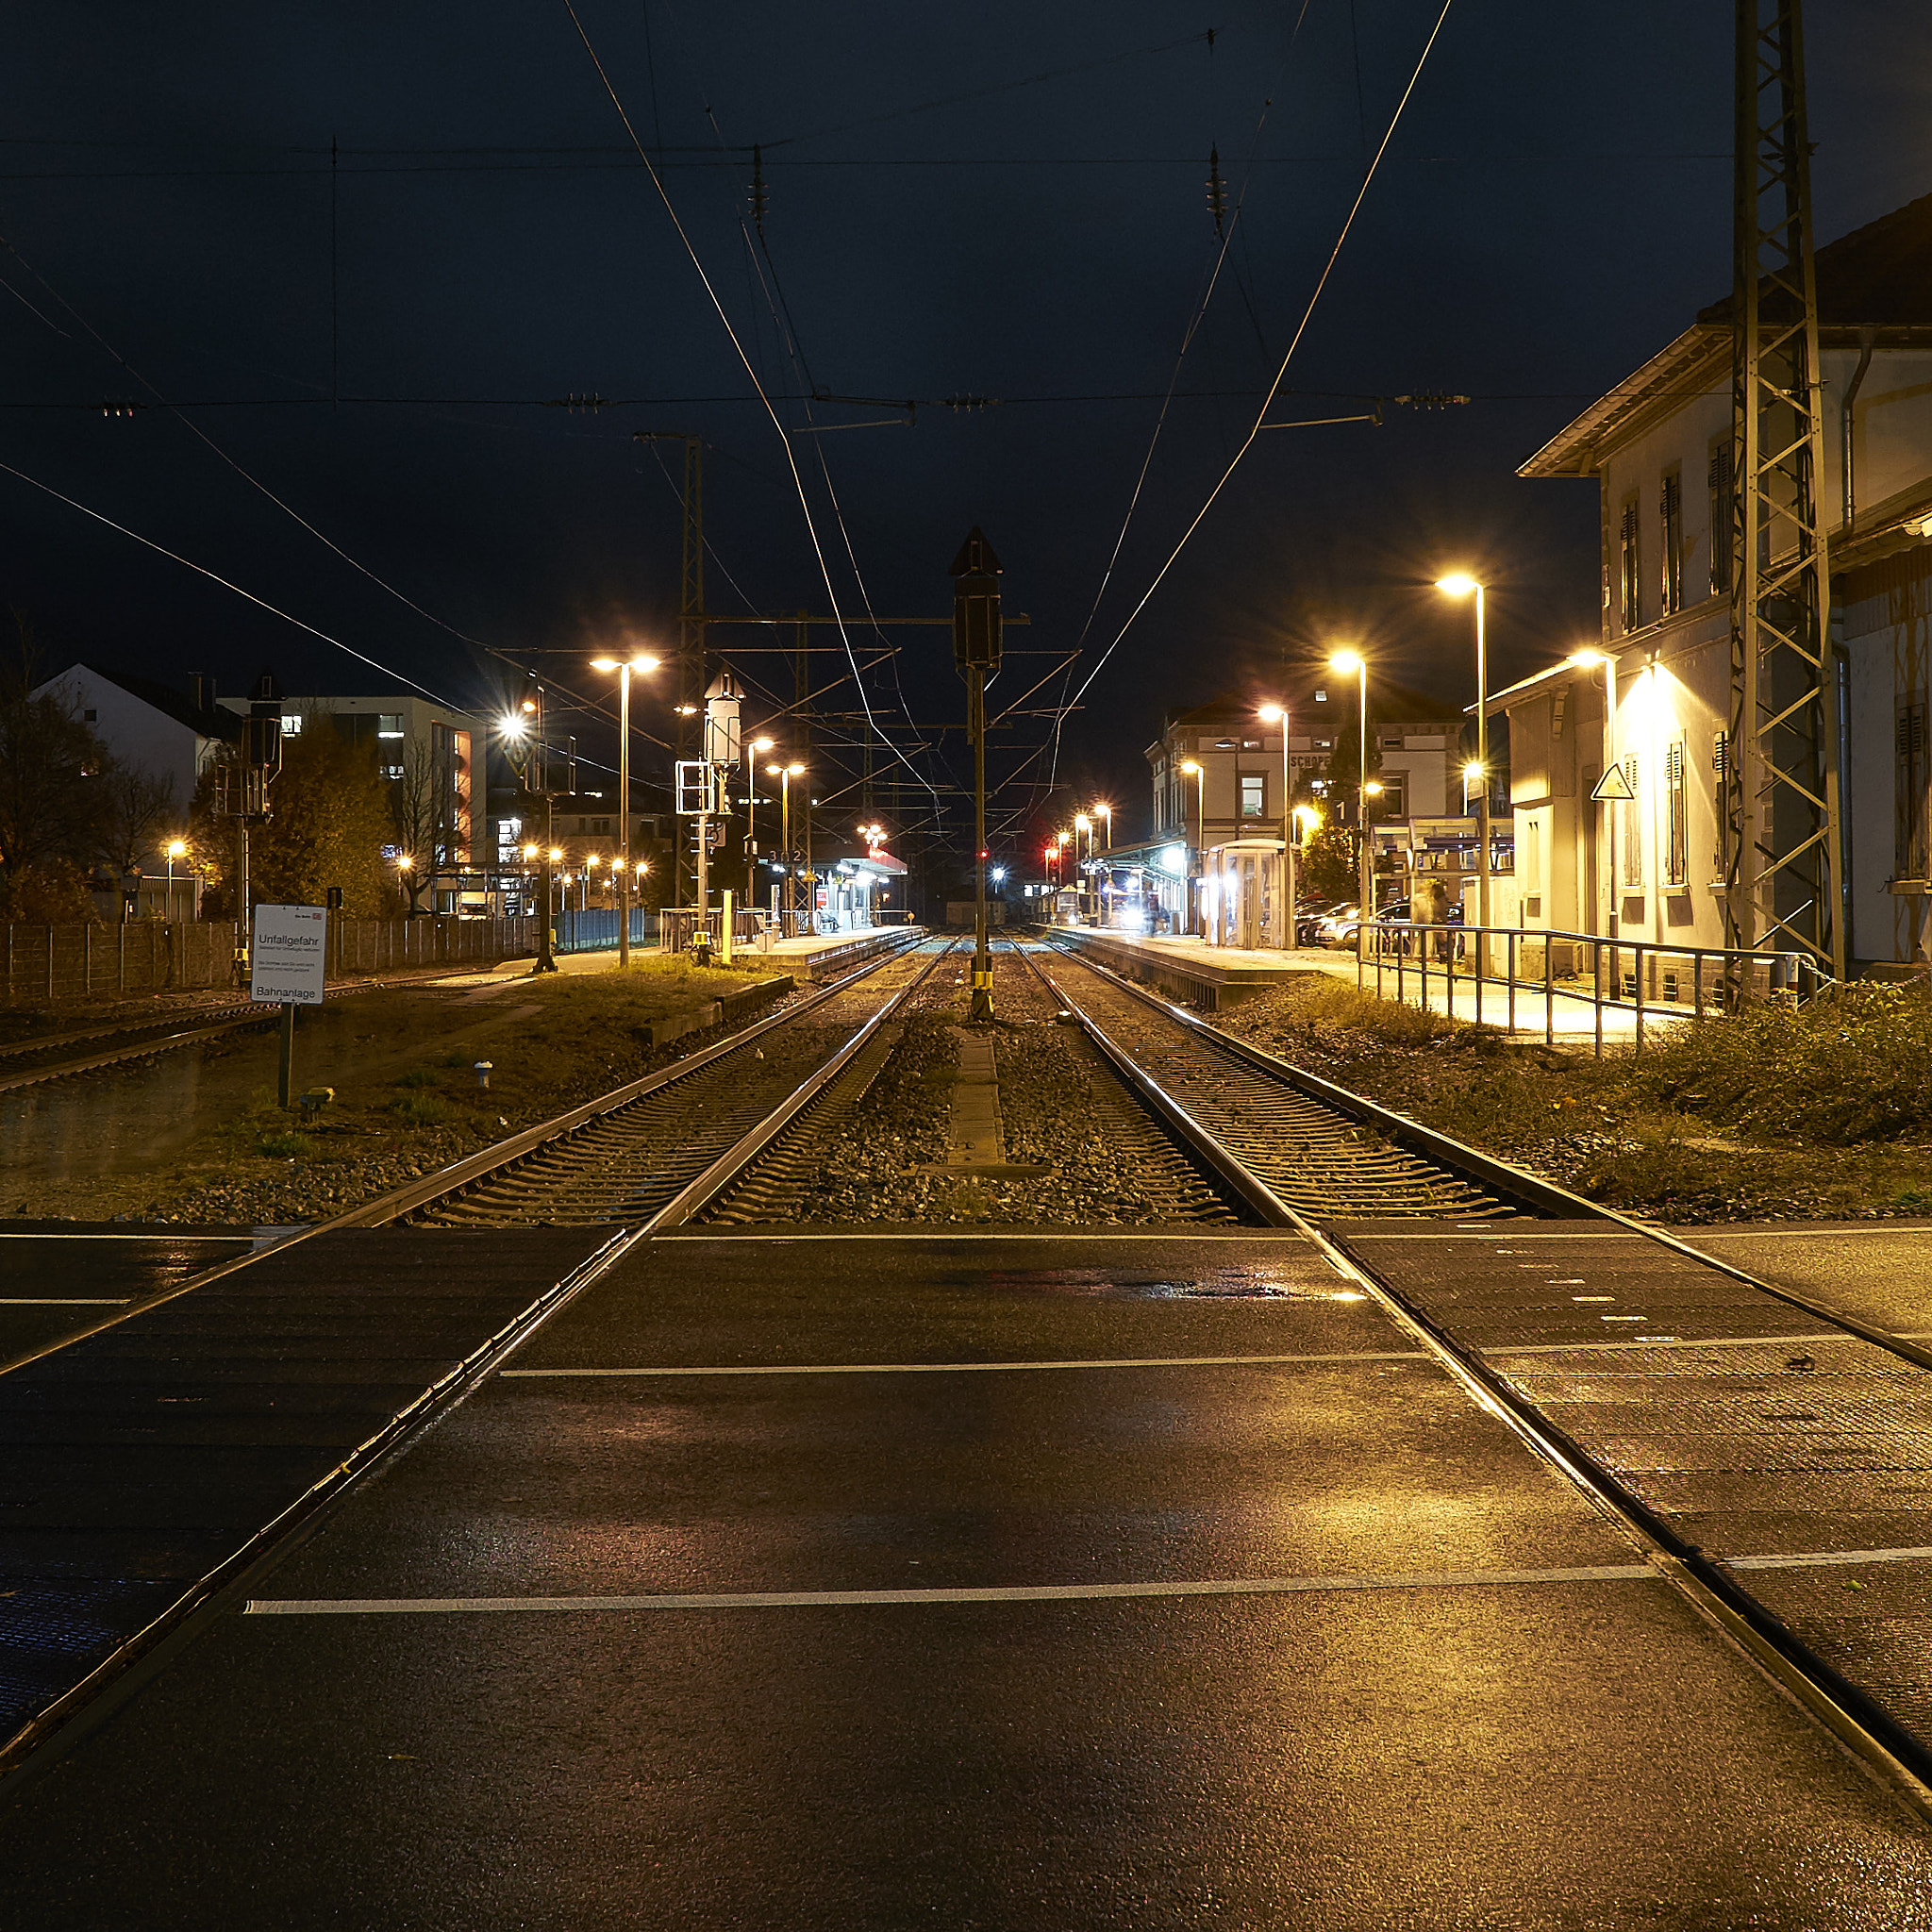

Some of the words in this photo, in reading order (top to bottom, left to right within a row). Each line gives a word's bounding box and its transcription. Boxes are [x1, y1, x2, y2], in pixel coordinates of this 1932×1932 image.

[1336, 801, 1345, 820] 1
[769, 850, 776, 861] 3
[793, 850, 801, 861] 2
[258, 935, 319, 946] Unfallgefahr
[257, 987, 315, 999] Bahnanlage
